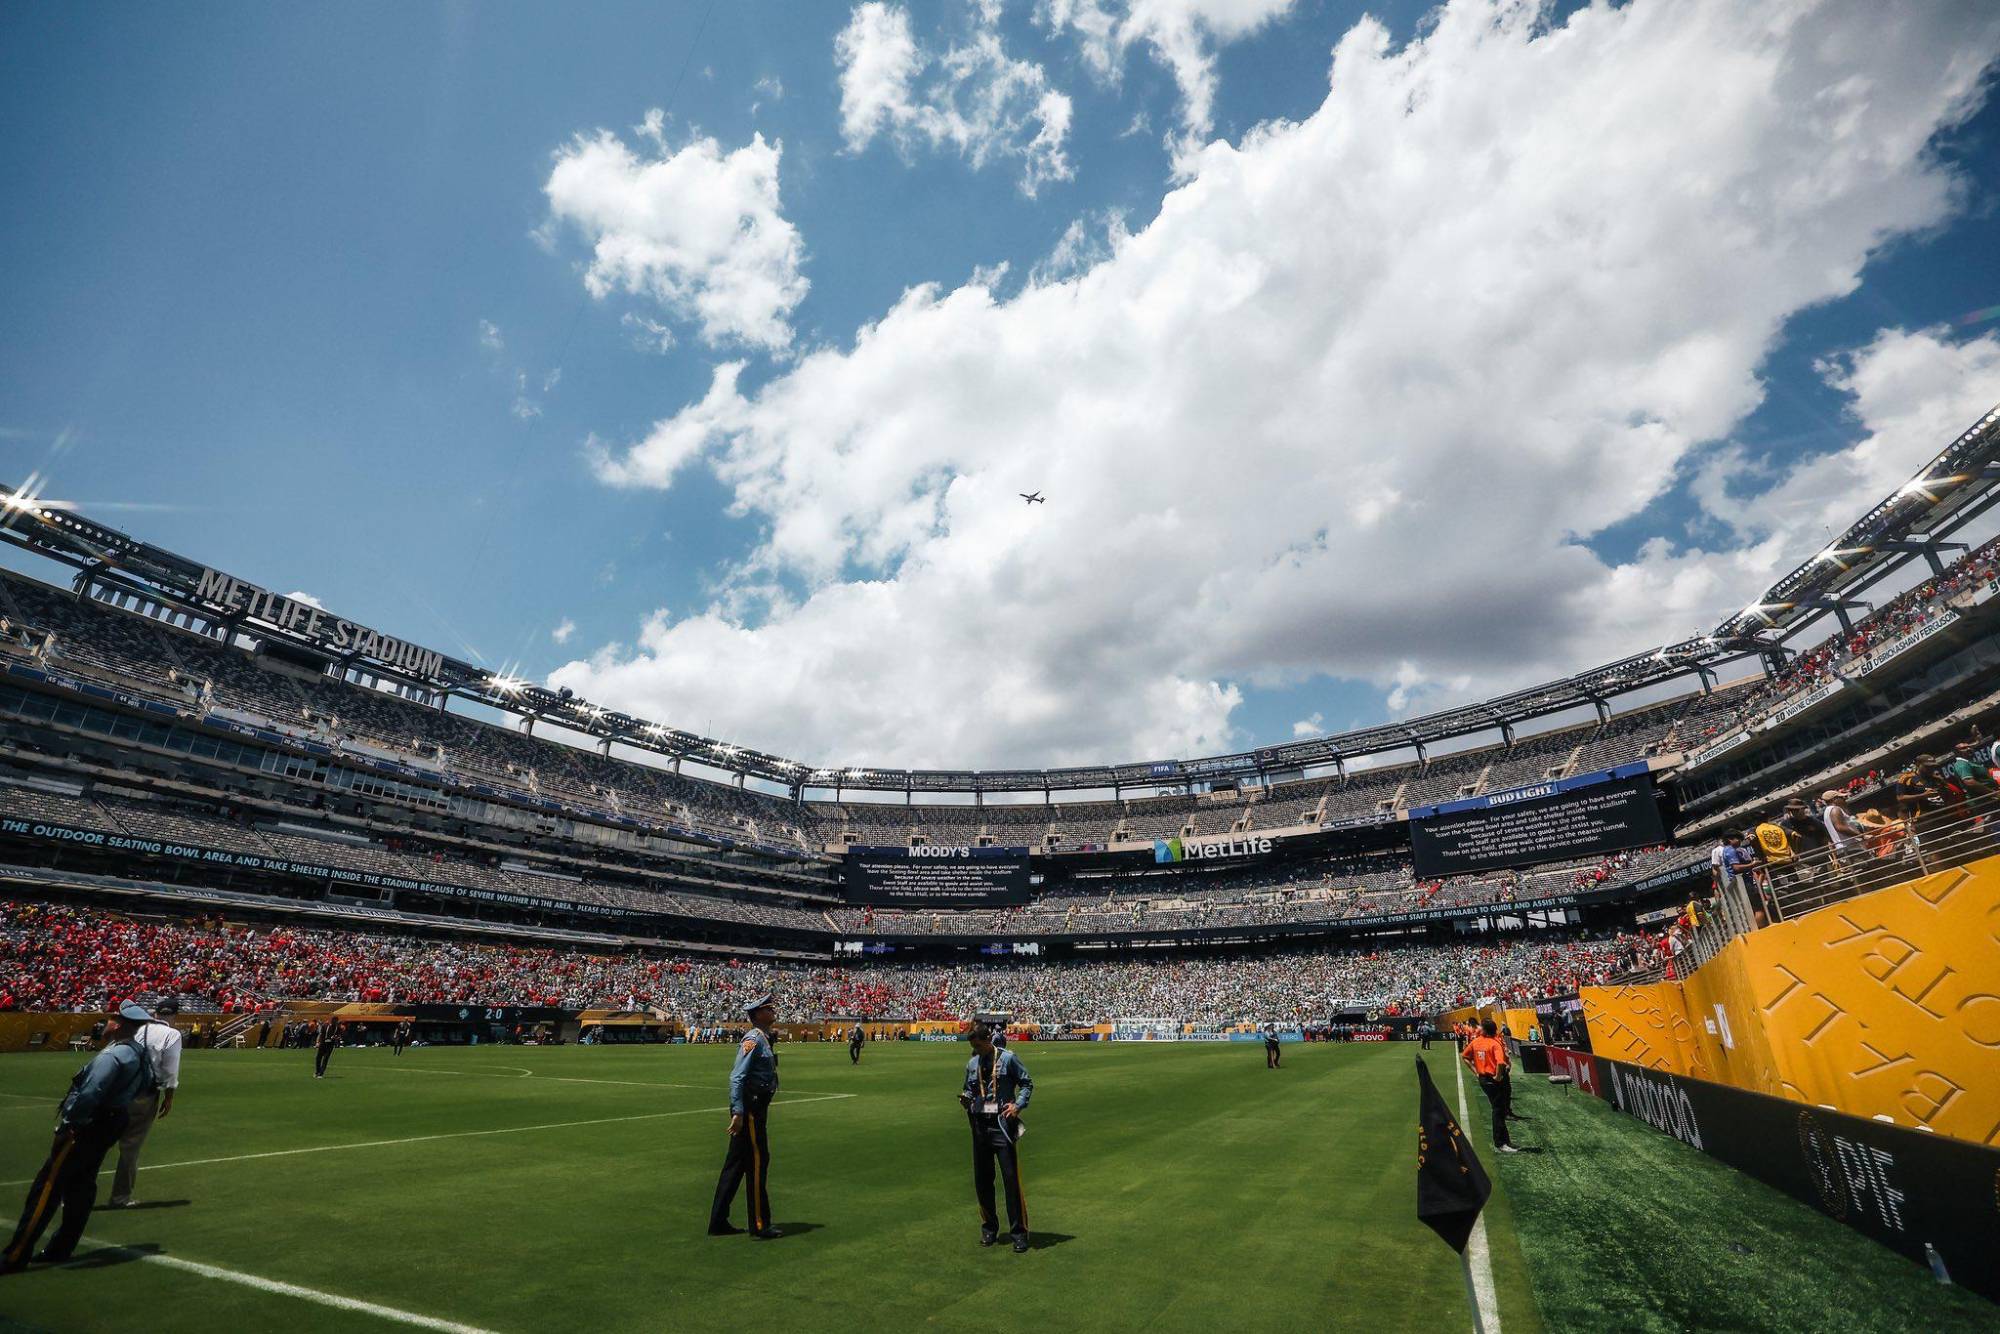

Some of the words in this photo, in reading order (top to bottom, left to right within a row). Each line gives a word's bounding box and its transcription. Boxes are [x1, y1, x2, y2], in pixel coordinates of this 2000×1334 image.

[196, 568, 327, 638] METLIFE
[332, 619, 443, 679] STADIUM
[1920, 611, 1956, 638] FERGUSON
[1786, 700, 1805, 716] WAYNE
[1805, 687, 1830, 706] CHREBET
[1488, 792, 1514, 805] BUD
[1516, 785, 1553, 800] LIGHT
[1440, 822, 1466, 831] attention
[1560, 801, 1579, 810] going
[1606, 789, 1637, 800] everyone
[1462, 825, 1484, 834] Seating
[1600, 799, 1627, 809] stadium
[1482, 842, 1497, 851] field,
[1498, 841, 1518, 850] please
[1535, 834, 1555, 844] calmly
[1578, 827, 1602, 836] nearest
[1603, 821, 1628, 831] tunnel,
[1502, 832, 1528, 841] available
[1538, 827, 1555, 836] guide
[1571, 822, 1589, 830] assist
[1525, 821, 1550, 830] weather
[908, 846, 970, 858] MOODY'S
[1183, 836, 1272, 860] MetLife
[1548, 839, 1570, 848] service
[1572, 835, 1600, 845] corridor.
[2, 819, 29, 833] THE
[33, 824, 105, 845] OUTDOOR
[108, 836, 161, 853] SEATING
[164, 846, 200, 859] BOWL
[202, 851, 233, 863] AREA
[235, 856, 260, 867] AND
[263, 859, 288, 872] TAKE
[290, 864, 328, 877] SHELTER
[331, 870, 361, 882] INSIDE
[363, 874, 380, 884] THE
[382, 877, 418, 890] STADIUM
[420, 883, 454, 895] BECAUSE
[469, 890, 495, 900] SEVERE
[497, 894, 529, 905] WEATHER
[540, 899, 552, 907] THE
[554, 902, 573, 910] AREA.
[577, 905, 599, 913] PLEASE
[1672, 868, 1690, 880] PLEASE.
[1691, 865, 1701, 874] FOR
[1388, 914, 1408, 922] EVENT
[1409, 912, 1427, 920] STAFF
[1444, 907, 1478, 917] AVAILABLE
[1533, 898, 1557, 907] ASSIST
[1558, 896, 1576, 904] YOU.
[485, 1008, 502, 1019] 2:0
[920, 1034, 957, 1042] Hisense
[1354, 1033, 1384, 1041] enovo
[1625, 1068, 1704, 1151] motorola
[1834, 1135, 1904, 1231] PIF
